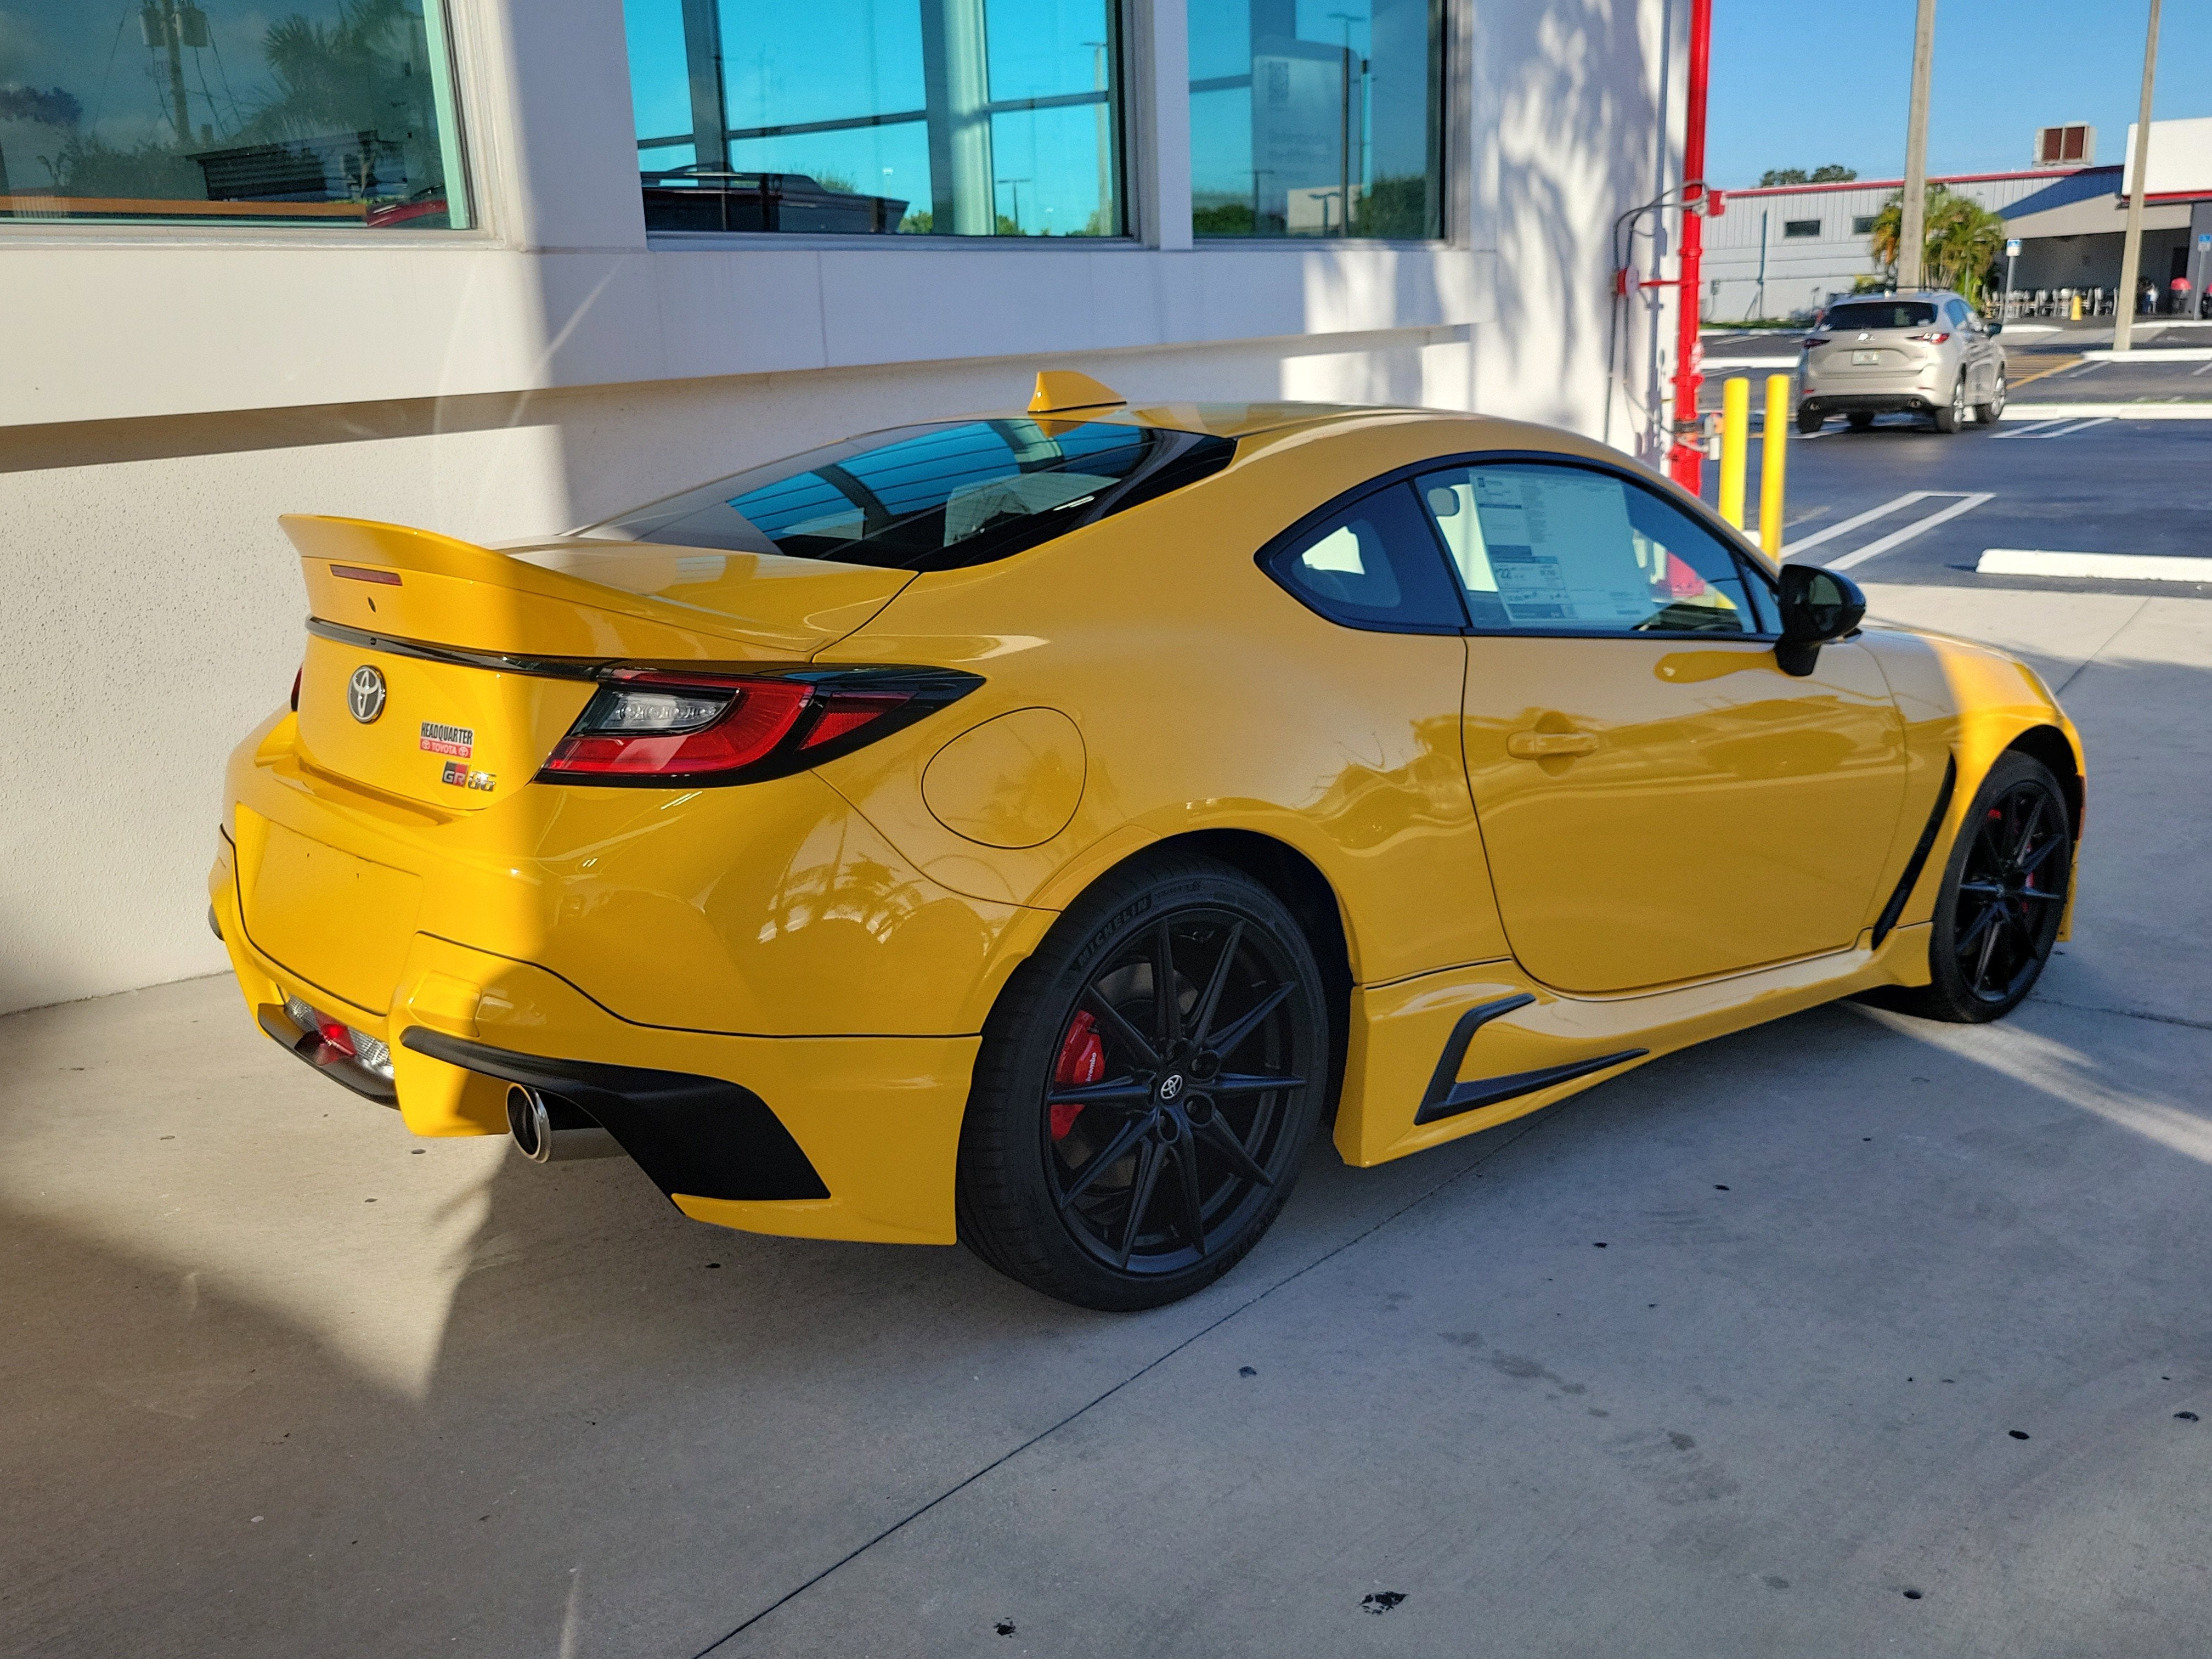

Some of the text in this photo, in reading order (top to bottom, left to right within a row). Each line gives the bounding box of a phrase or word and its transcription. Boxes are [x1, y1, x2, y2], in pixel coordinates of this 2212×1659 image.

[421, 722, 473, 745] HEADQUARTER
[431, 742, 458, 755] TOYOTA
[443, 770, 466, 786] GR
[1077, 898, 1149, 967] MICHELIN
[1086, 1052, 1097, 1081] brembo
